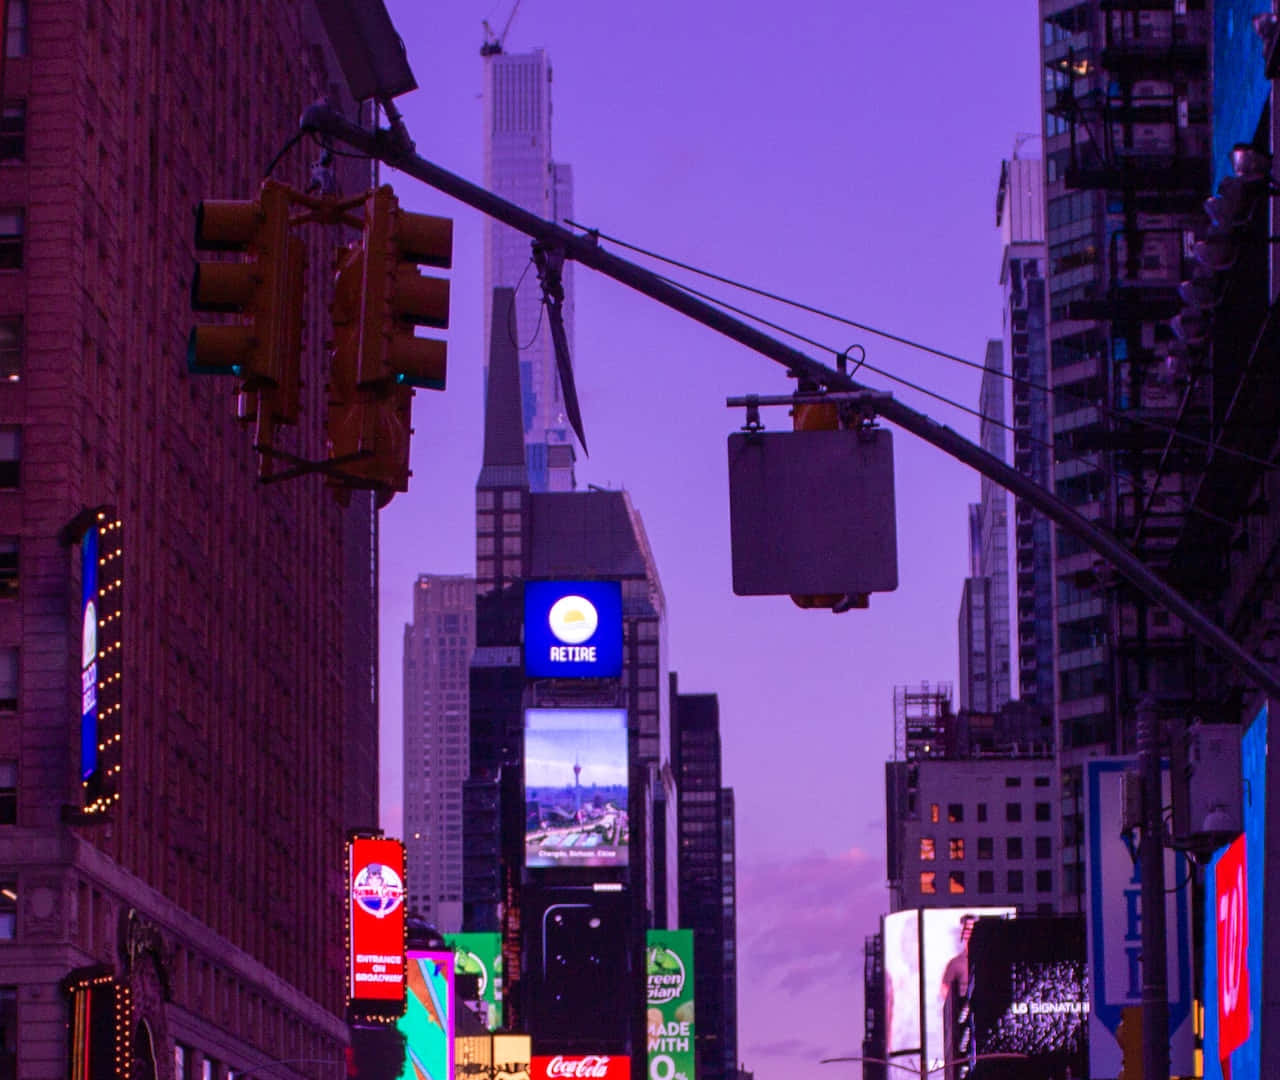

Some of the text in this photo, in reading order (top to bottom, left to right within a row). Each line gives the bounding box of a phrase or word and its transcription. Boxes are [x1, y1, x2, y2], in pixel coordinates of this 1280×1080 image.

[550, 646, 597, 662] RETIRE
[647, 973, 682, 985] reen
[1012, 1002, 1029, 1014] LG
